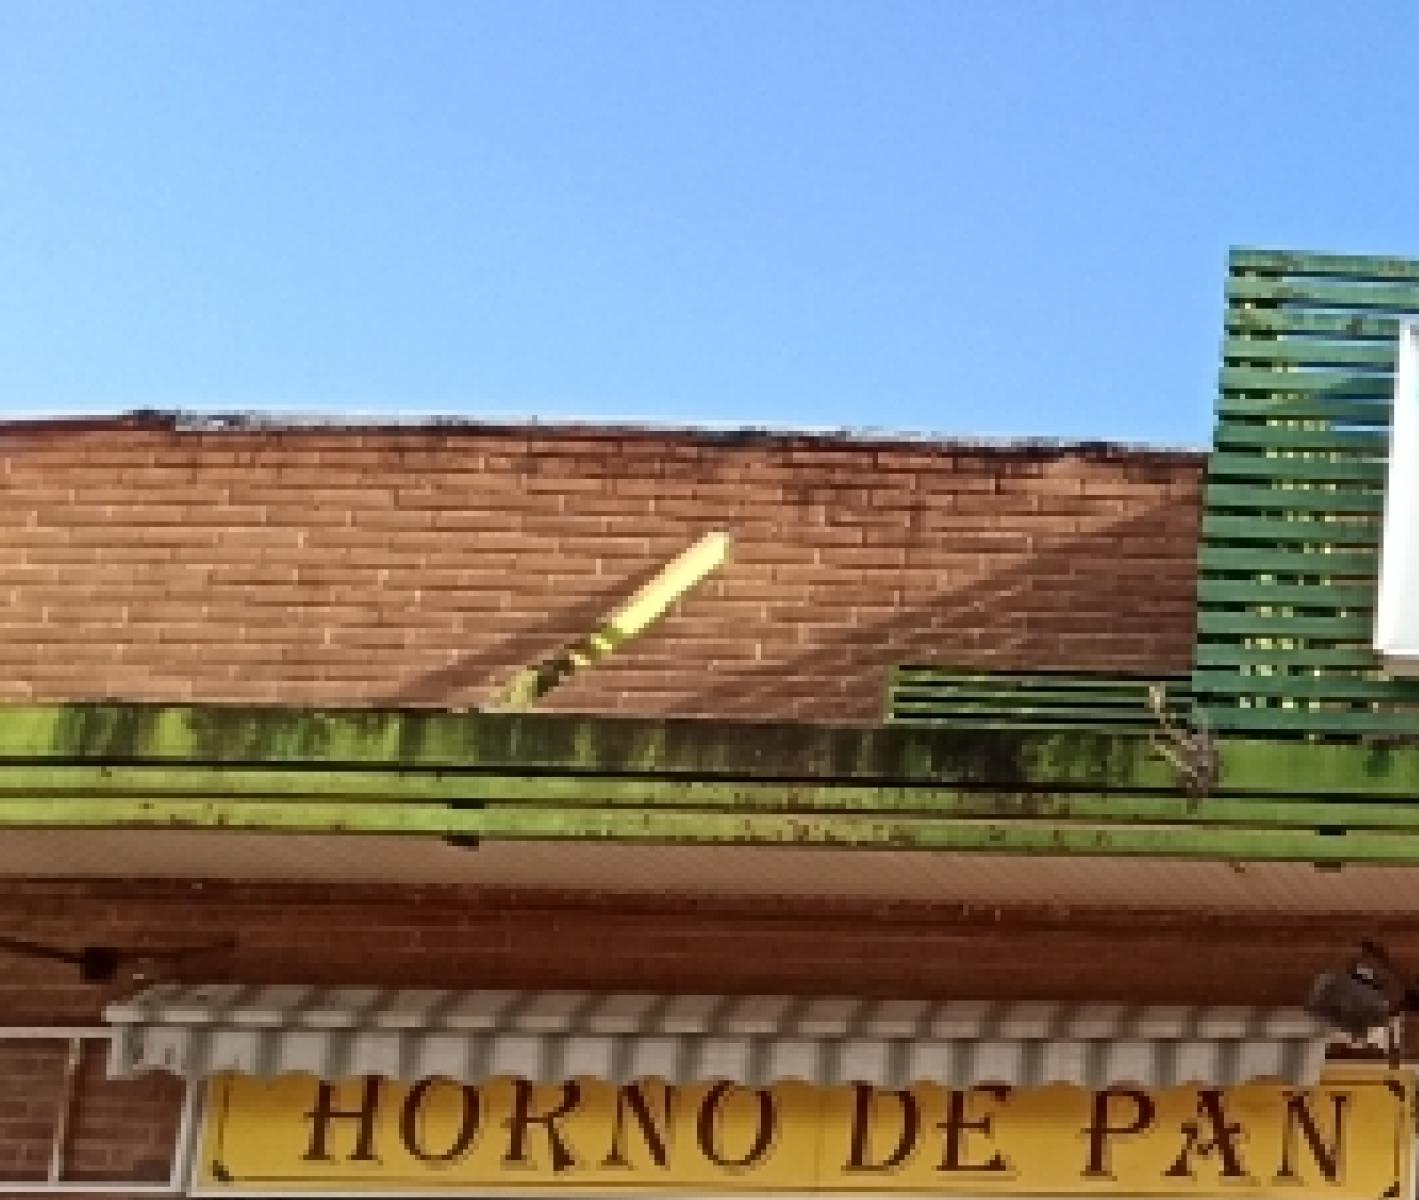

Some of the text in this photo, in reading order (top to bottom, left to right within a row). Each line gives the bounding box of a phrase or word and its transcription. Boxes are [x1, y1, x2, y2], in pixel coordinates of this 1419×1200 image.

[302, 1075, 1350, 1186] HORNO DE PAN
